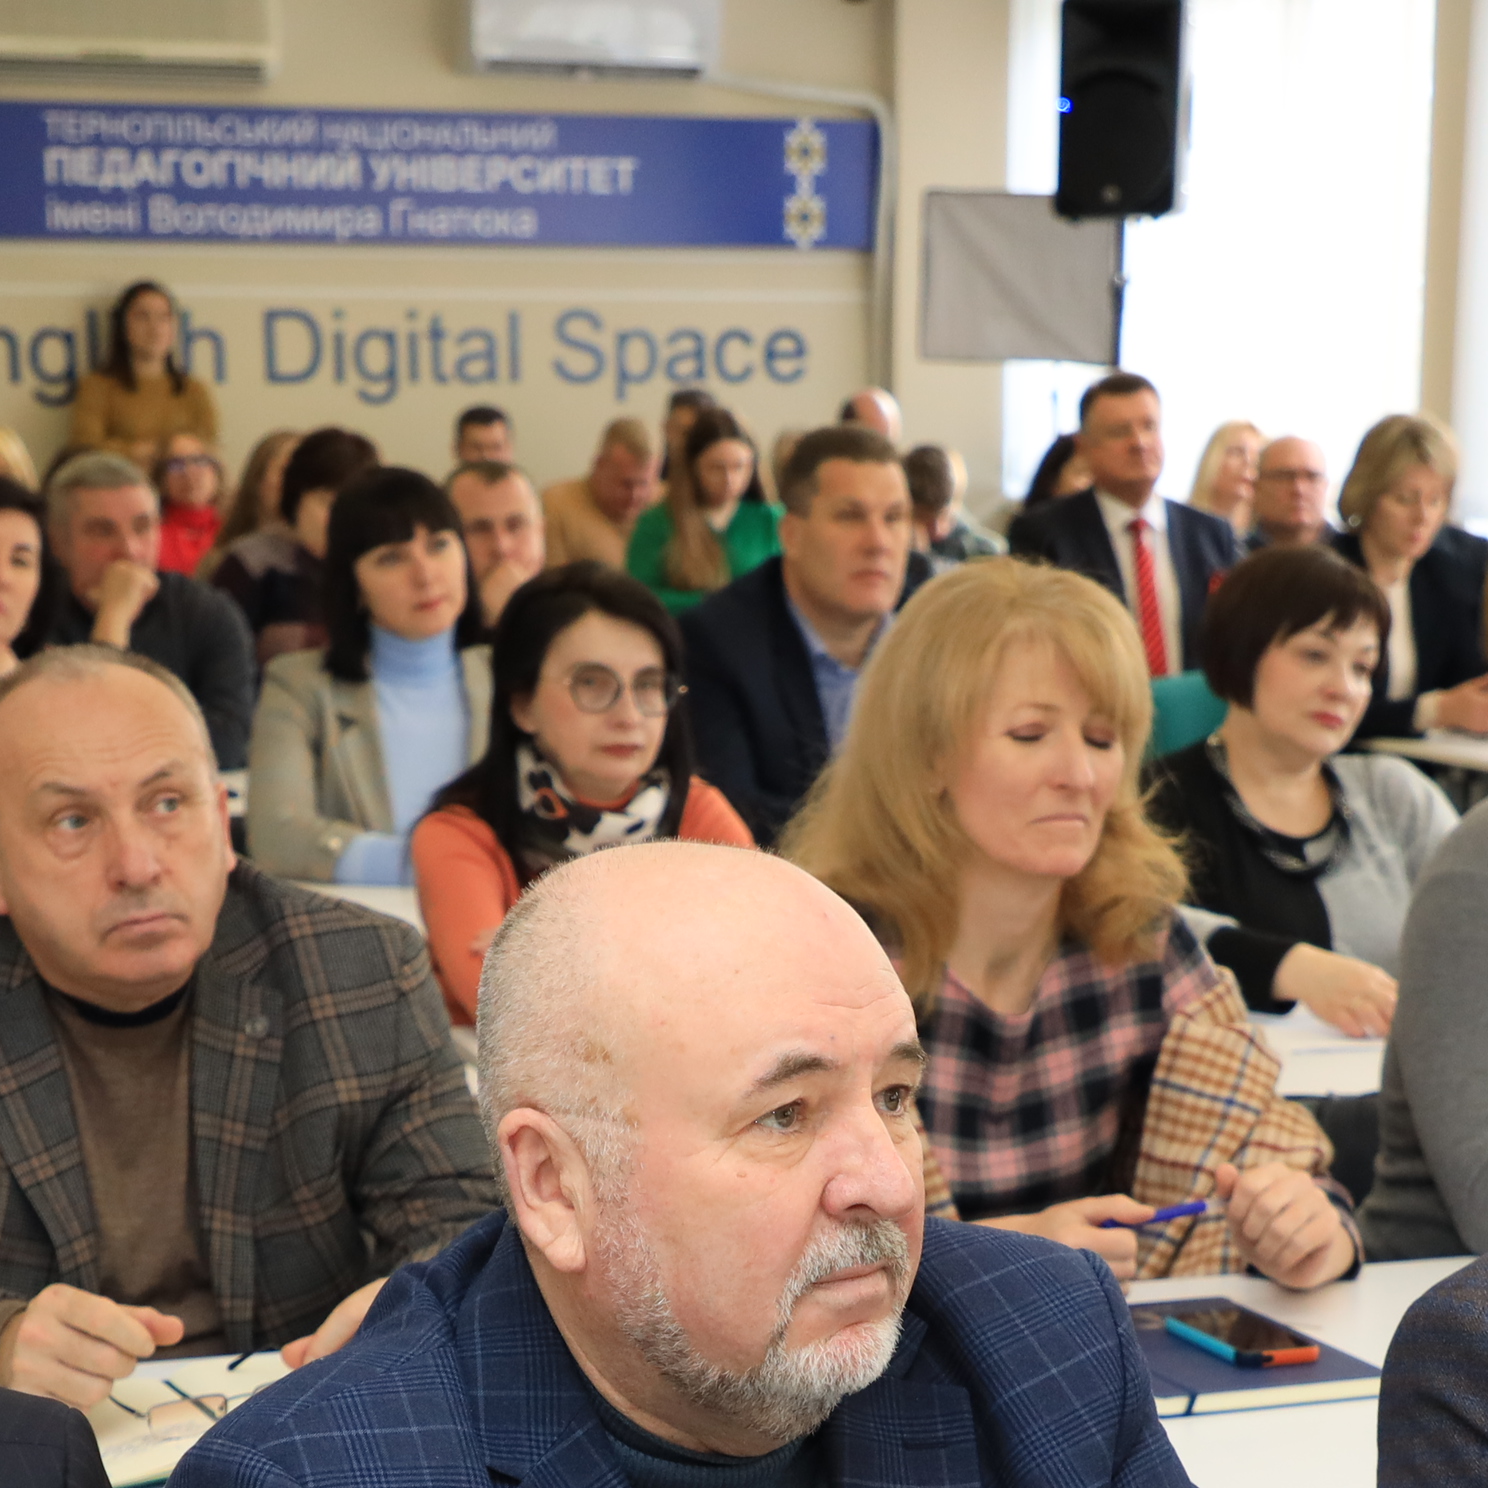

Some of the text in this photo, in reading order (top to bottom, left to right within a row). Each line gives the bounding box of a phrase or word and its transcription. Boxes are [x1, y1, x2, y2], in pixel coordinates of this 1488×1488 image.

[44, 110, 558, 151] ТЕРНОПІЛЬСЬКИЙ НАЦІОНАЛЬНИЙ
[44, 146, 639, 196] ПЕДАГОГІЧНИЙ УНІВЕРСИТЕТ
[46, 194, 539, 242] імені Володимира Гнатюка
[261, 308, 523, 406] Digital
[551, 308, 809, 401] Space
